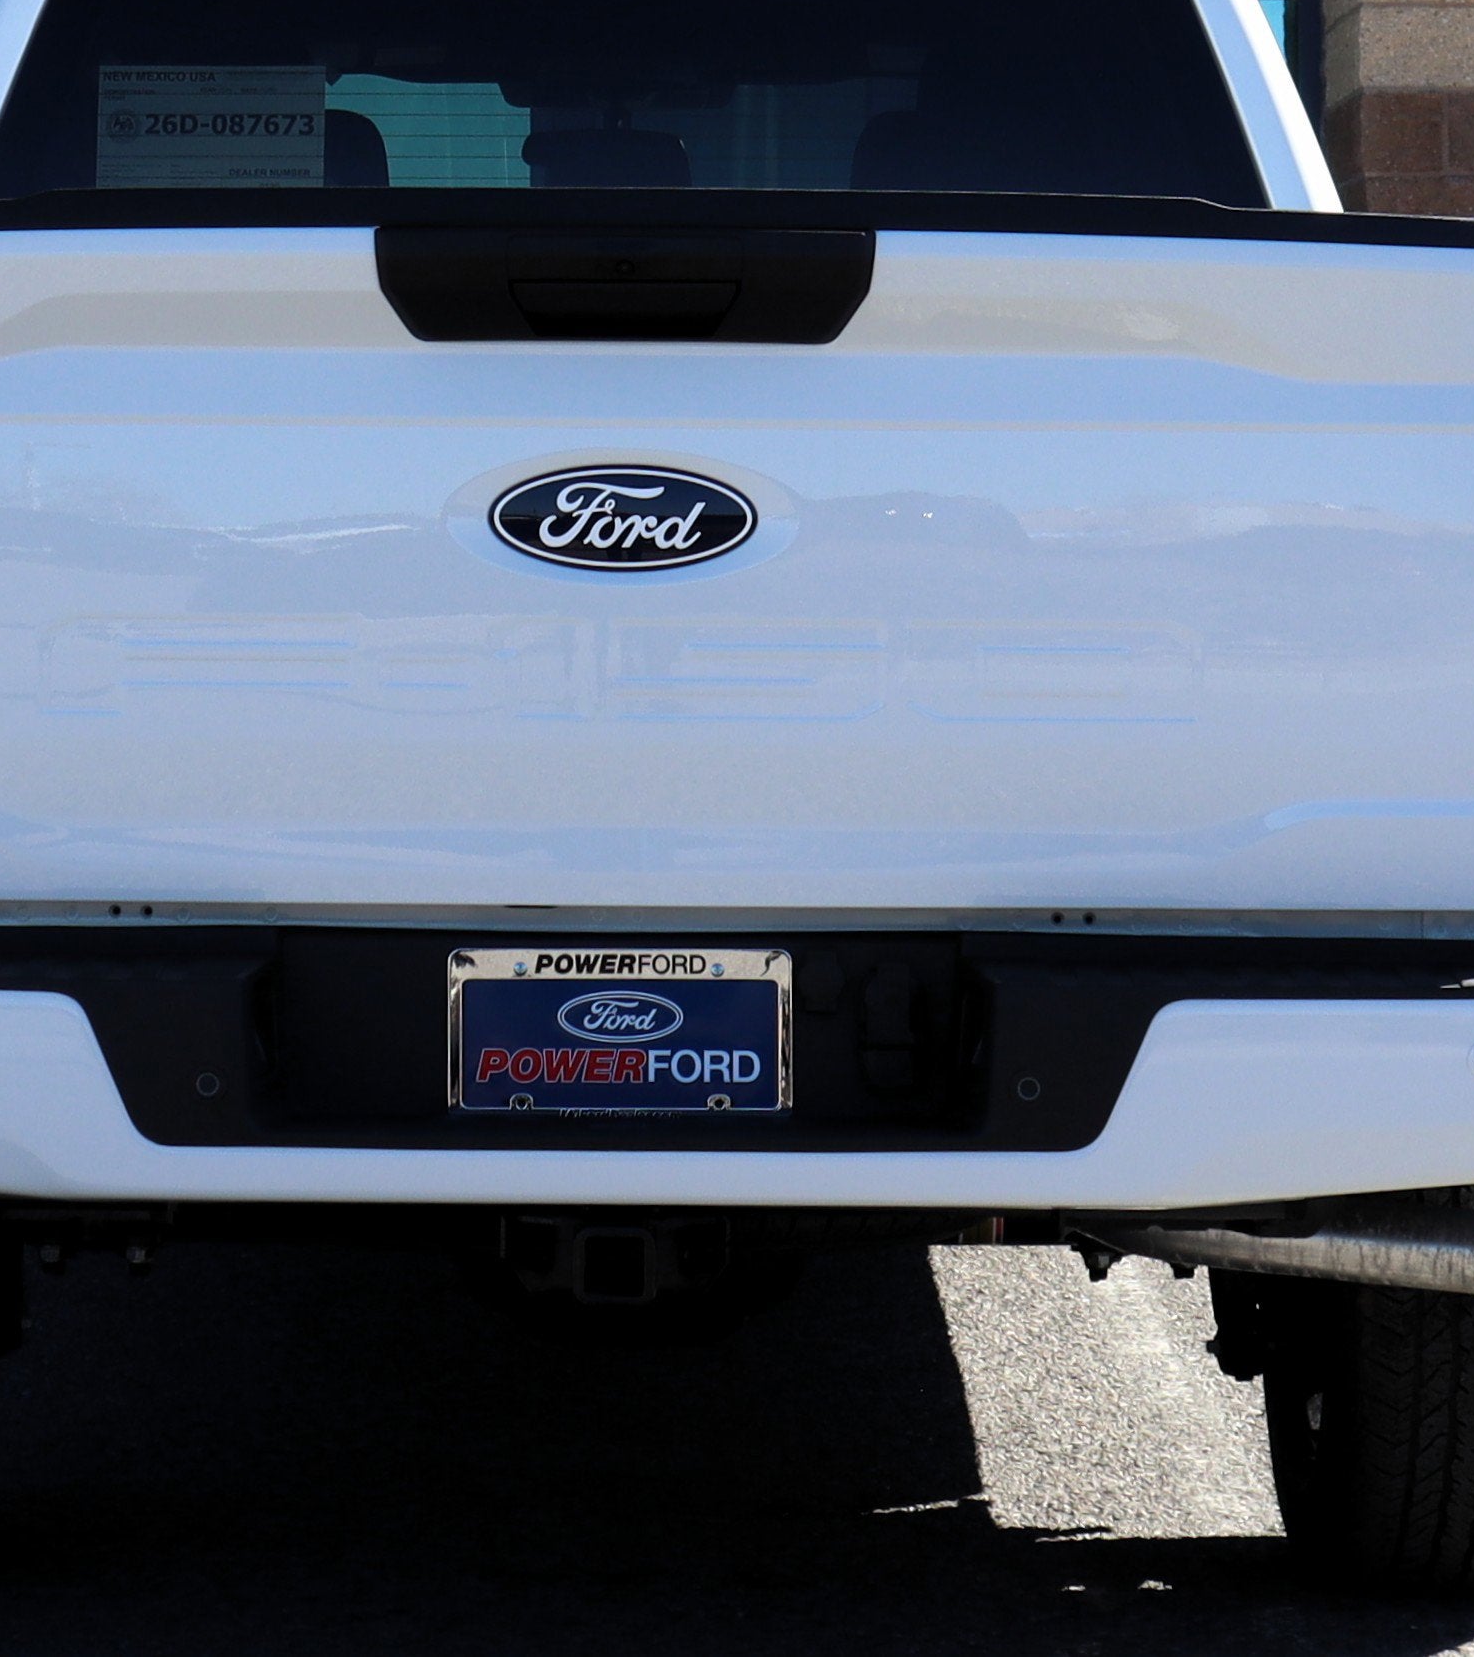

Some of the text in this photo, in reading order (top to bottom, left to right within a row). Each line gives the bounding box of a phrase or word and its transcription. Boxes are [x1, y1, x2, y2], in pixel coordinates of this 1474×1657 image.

[103, 71, 132, 83] NEW
[136, 71, 186, 83] MEXICO
[190, 71, 217, 83] USA
[144, 113, 315, 136] 26D-087673
[229, 168, 311, 178] DEALER NUMBER
[539, 482, 706, 550] Ford
[583, 999, 658, 1031] Ford
